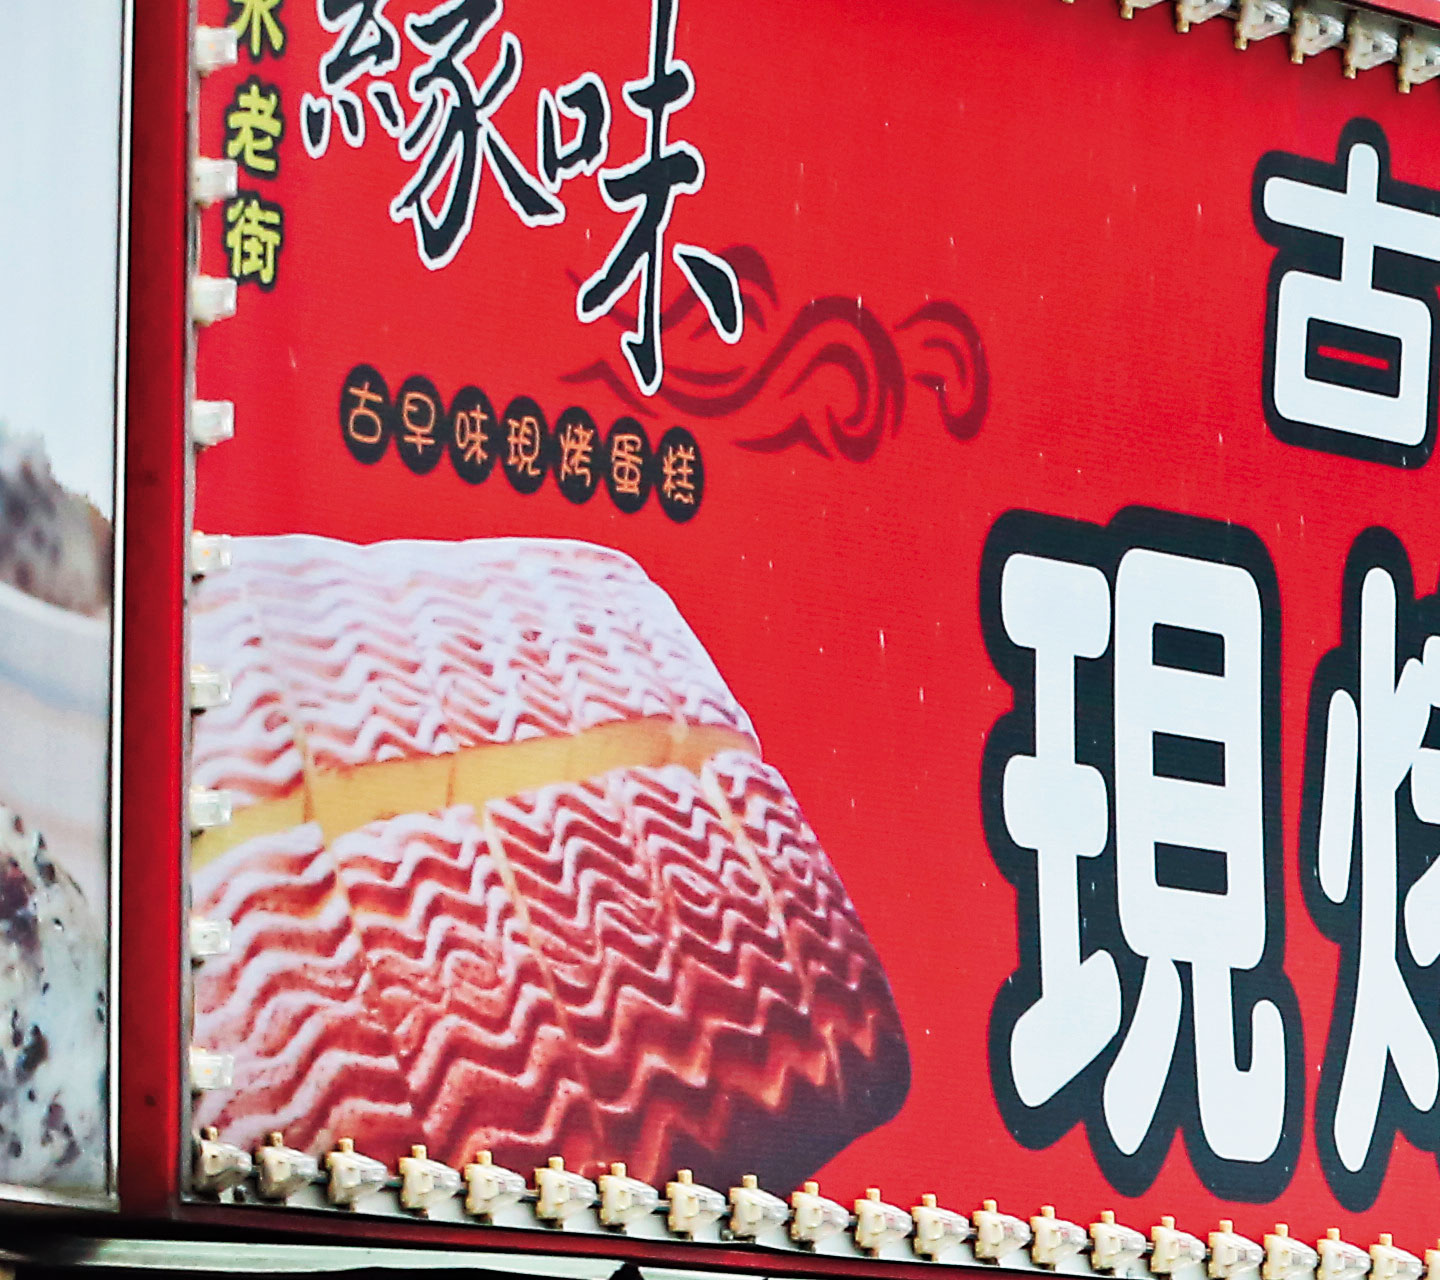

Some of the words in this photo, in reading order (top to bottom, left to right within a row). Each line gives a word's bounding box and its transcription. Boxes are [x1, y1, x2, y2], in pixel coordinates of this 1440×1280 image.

[346, 378, 702, 508] 古早味現烤蛋糕
